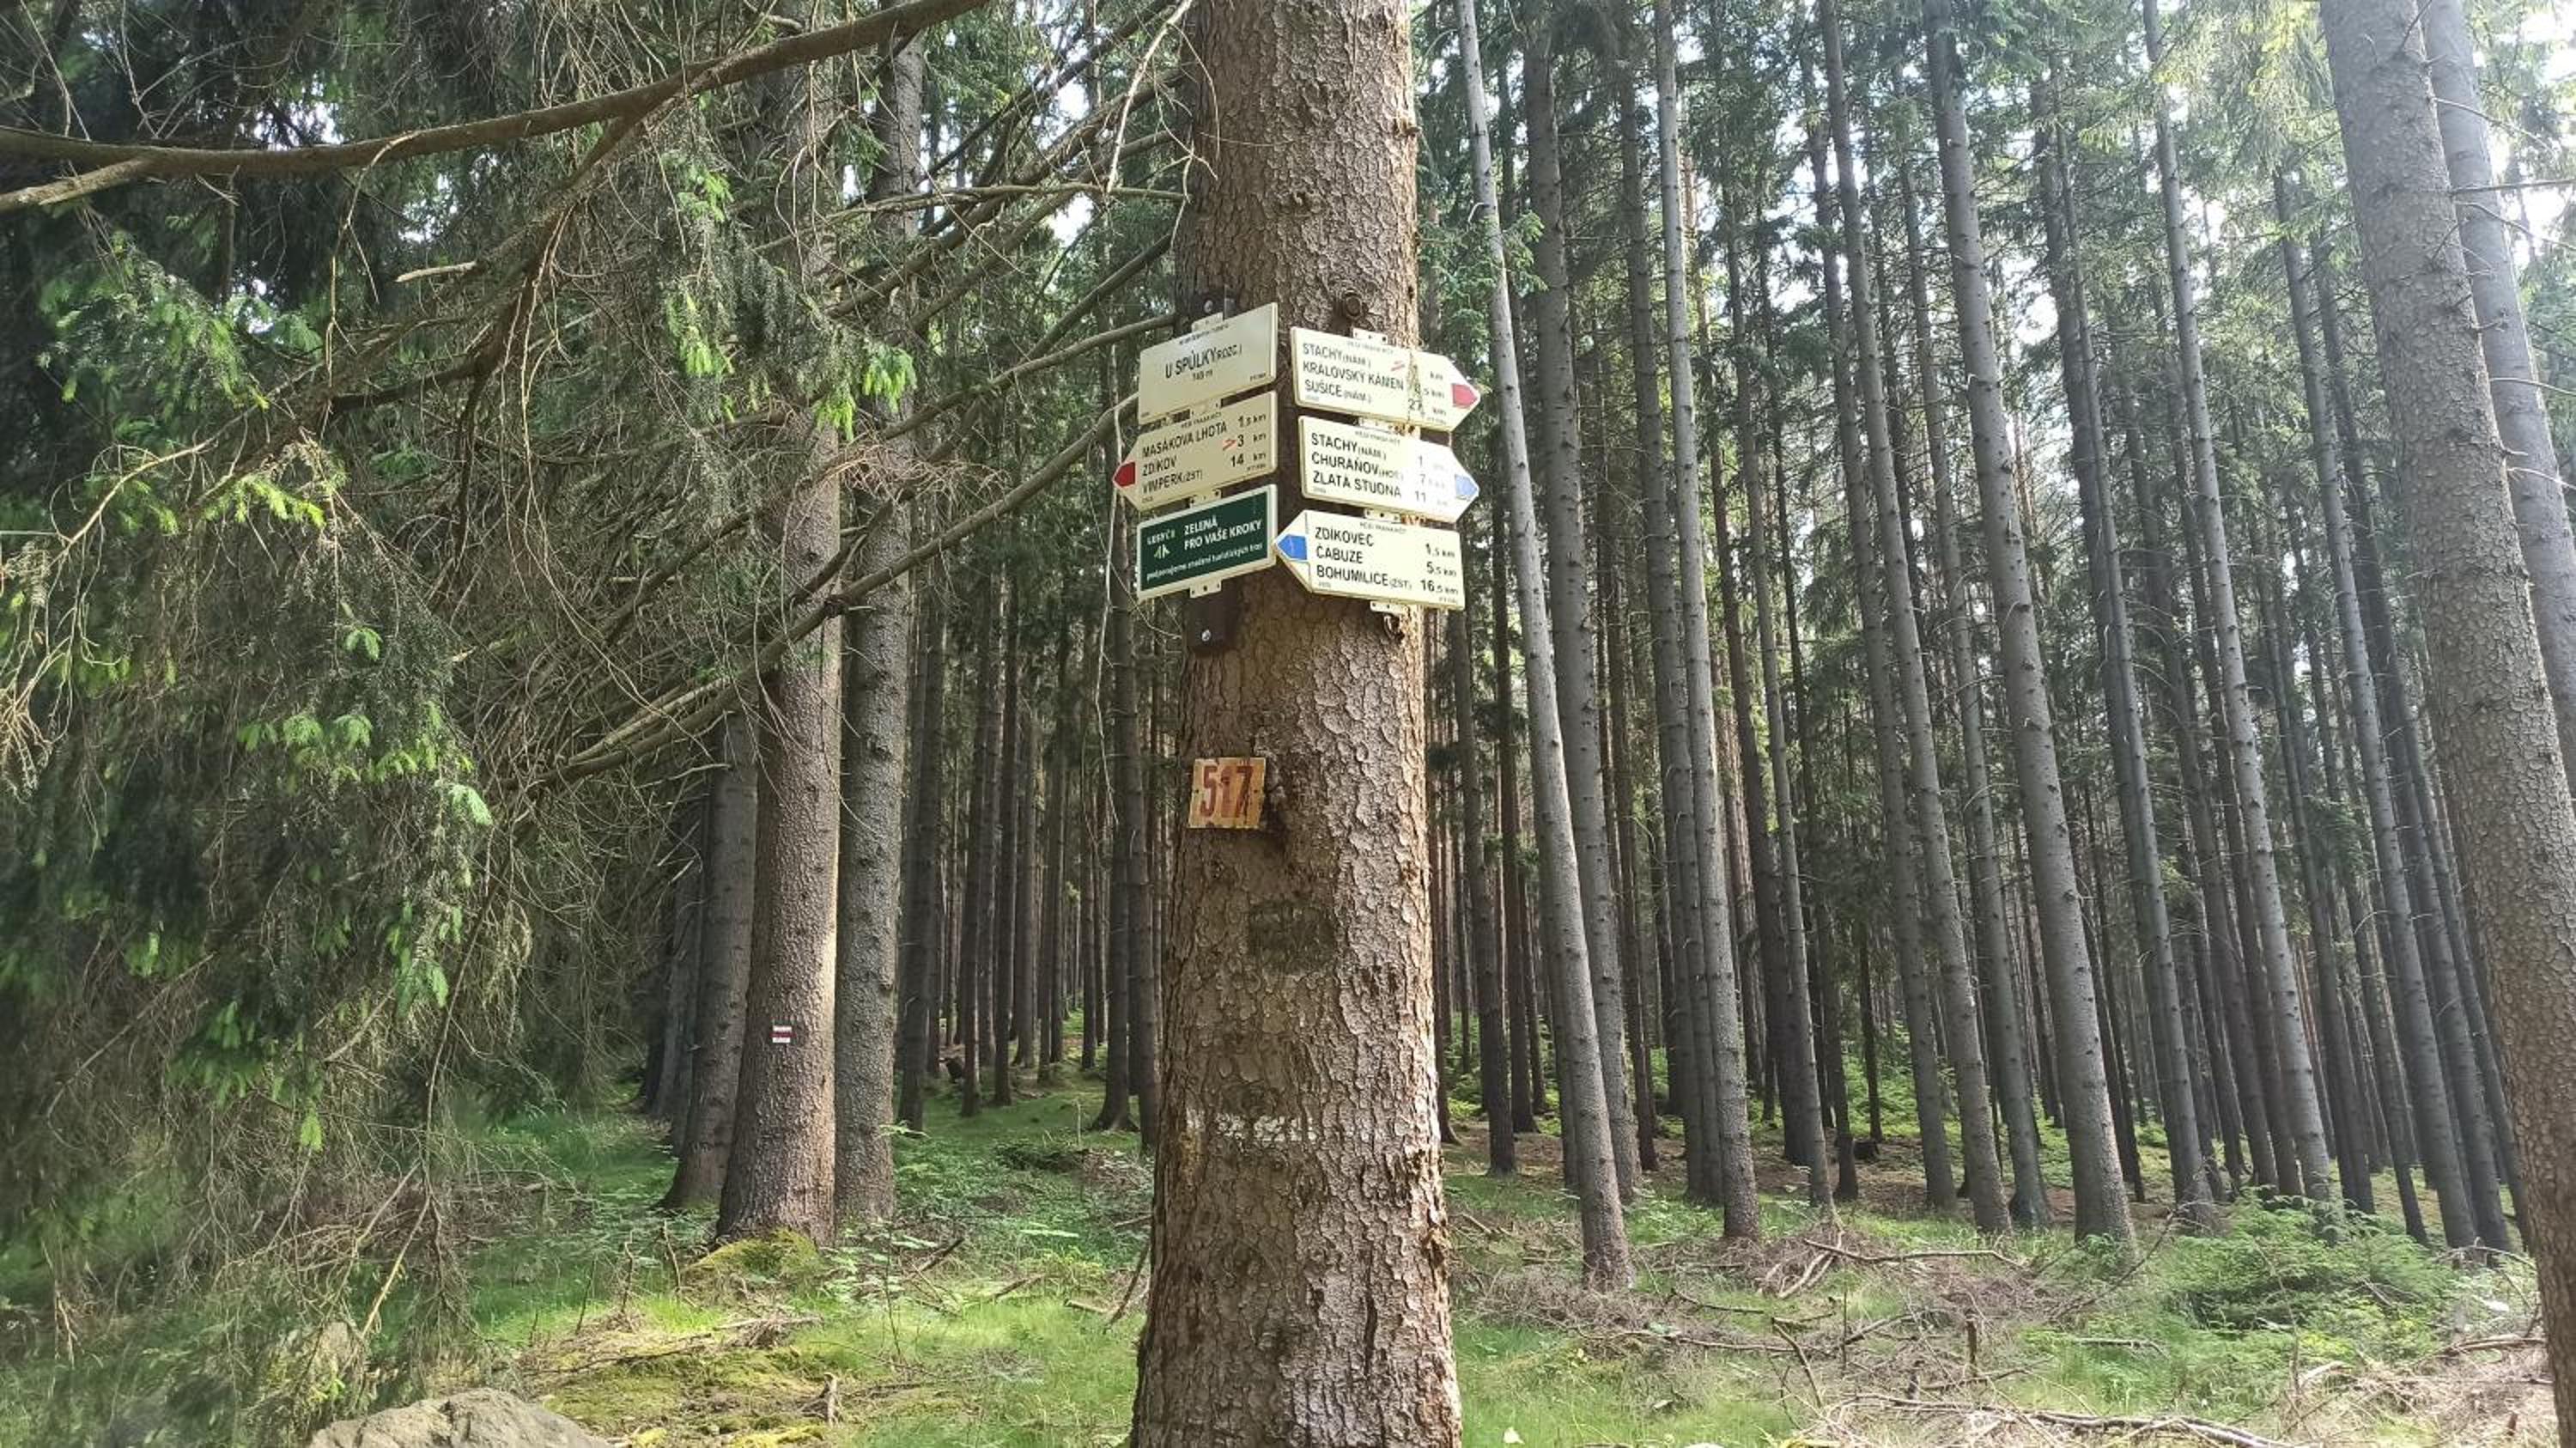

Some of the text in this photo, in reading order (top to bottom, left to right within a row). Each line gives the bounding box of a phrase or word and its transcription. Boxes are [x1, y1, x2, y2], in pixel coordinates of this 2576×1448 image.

[1165, 363, 1172, 378] U
[1304, 379, 1342, 397] SUŠICE
[1196, 421, 1228, 441] LHOTA
[1254, 414, 1267, 423] km
[1237, 435, 1244, 447] 3
[1254, 433, 1267, 442] km
[1311, 432, 1358, 453] STACHY
[1142, 473, 1182, 494] VIMPERK
[1231, 453, 1244, 468] 14
[1254, 453, 1267, 461] km
[1312, 470, 1351, 488] ZLATÁ
[1354, 478, 1401, 498] STUDNA
[1184, 515, 1218, 535] ZELENÁ
[1184, 519, 1262, 551] PRO VAŠE KROKY
[1315, 526, 1375, 548] ZDÍKOVEC
[1442, 549, 1455, 557] km
[1315, 542, 1364, 564] ČABUZE
[1443, 568, 1457, 577] km
[1316, 564, 1388, 587] BOHUMILICE
[1444, 586, 1459, 595] km
[1200, 765, 1254, 818] 517
